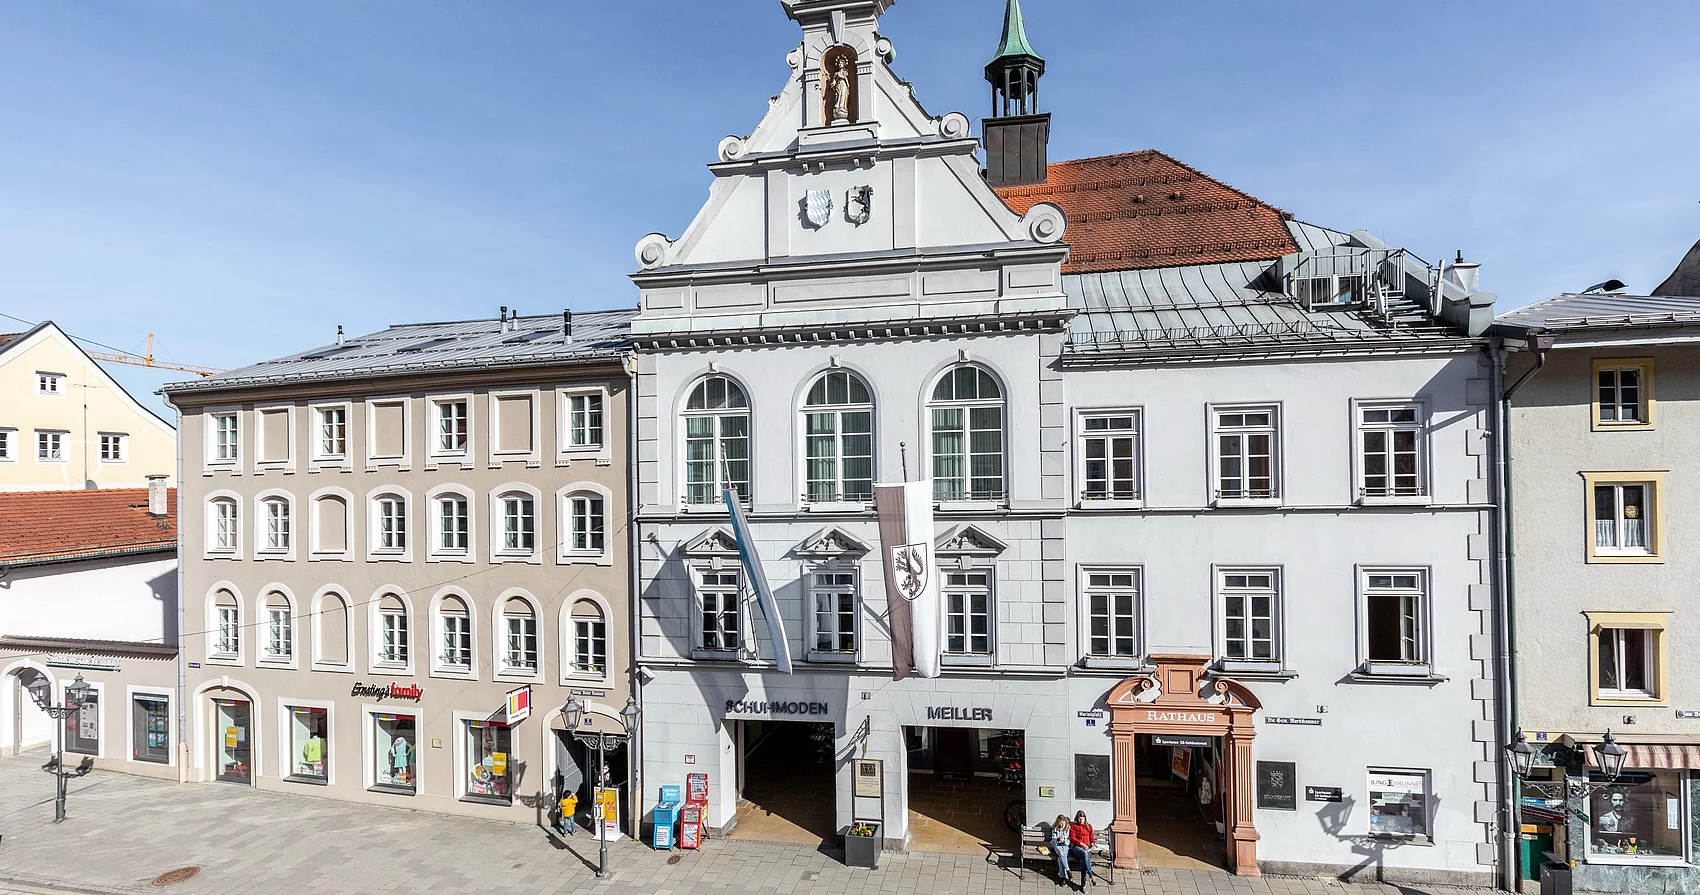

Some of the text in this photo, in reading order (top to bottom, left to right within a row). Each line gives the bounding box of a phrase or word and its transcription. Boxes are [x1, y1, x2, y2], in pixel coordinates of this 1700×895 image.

[351, 682, 424, 702] Ernsting's family
[725, 700, 828, 714] SCHUHMODEN
[927, 706, 993, 721] MEILLER
